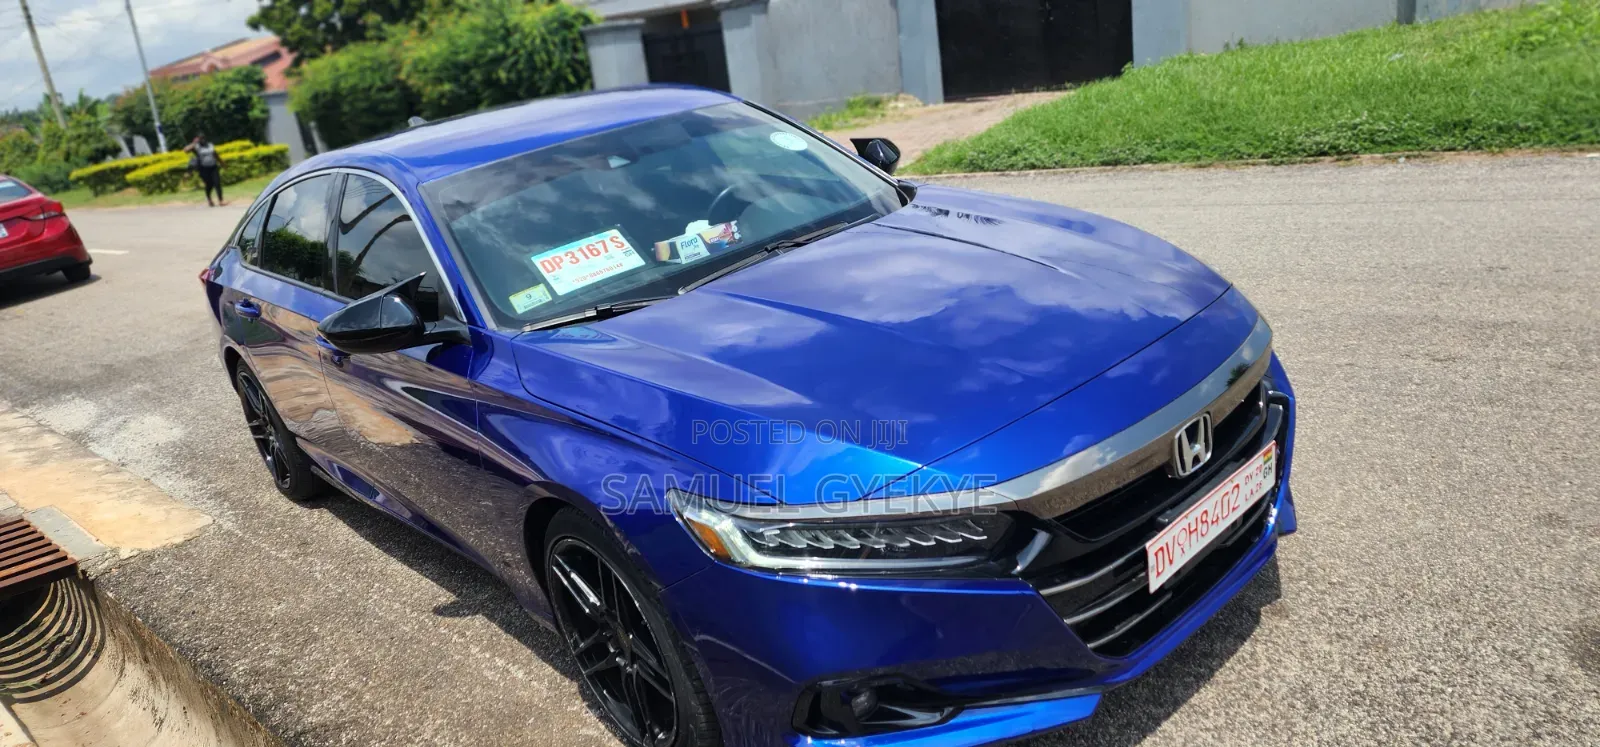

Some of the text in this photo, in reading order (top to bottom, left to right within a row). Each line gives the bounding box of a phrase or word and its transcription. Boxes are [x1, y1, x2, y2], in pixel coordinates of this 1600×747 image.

[540, 236, 625, 274] DP 3167 S
[681, 237, 698, 250] Flora
[1263, 462, 1273, 479] GH
[1154, 535, 1176, 578] DV
